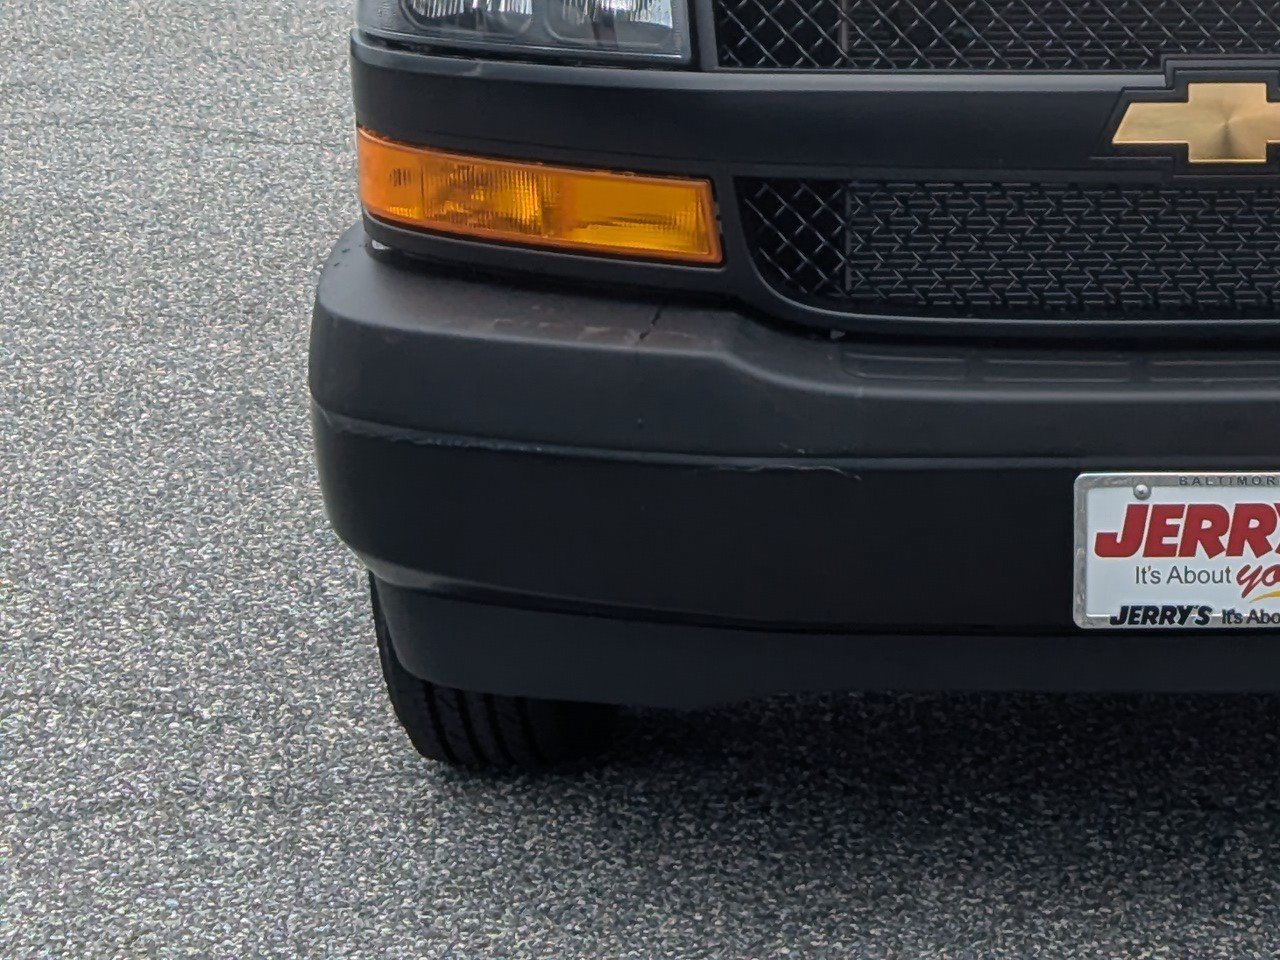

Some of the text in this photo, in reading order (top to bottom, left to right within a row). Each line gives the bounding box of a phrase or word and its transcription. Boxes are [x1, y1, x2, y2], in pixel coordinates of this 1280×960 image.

[1135, 565, 1161, 584] It's
[1166, 565, 1231, 585] About
[1109, 605, 1213, 626] JERRY'S
[1222, 608, 1243, 625] It's
